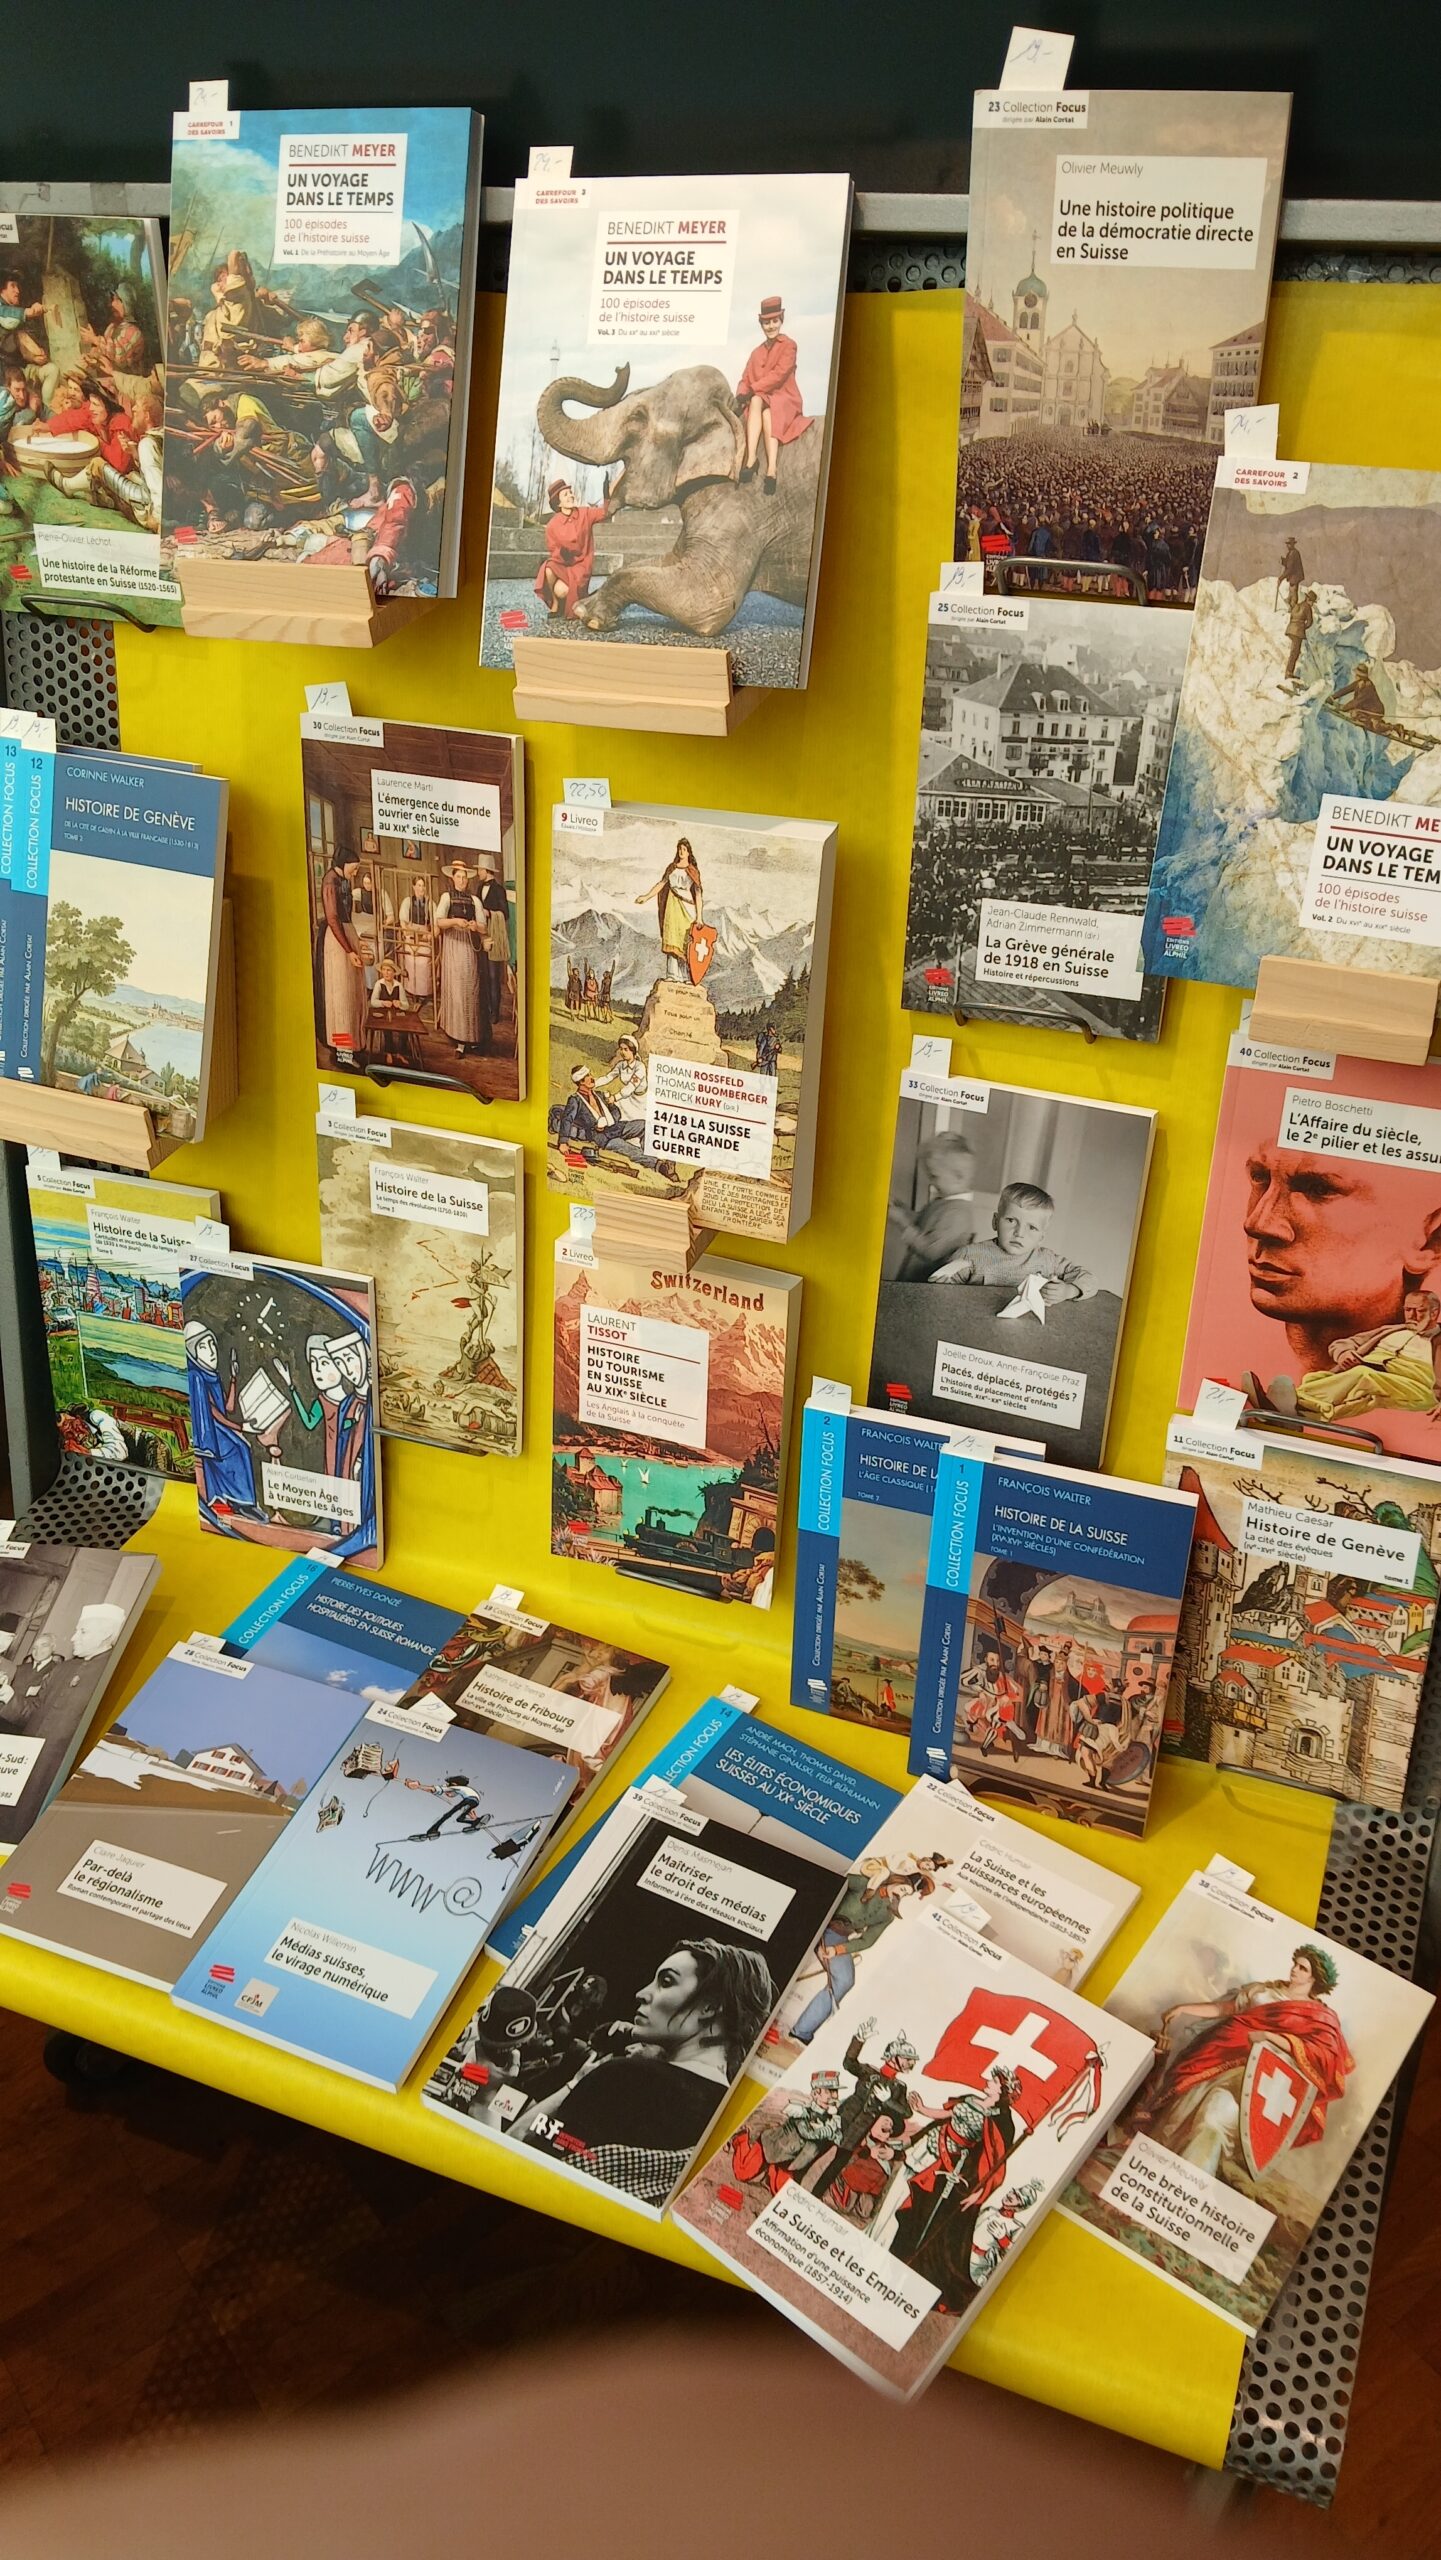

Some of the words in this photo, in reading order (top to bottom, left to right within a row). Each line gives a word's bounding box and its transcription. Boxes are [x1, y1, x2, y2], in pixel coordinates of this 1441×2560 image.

[1003, 102, 1053, 113] Collection
[1056, 102, 1086, 113] Focus
[289, 144, 348, 158] BENEDIKT
[351, 144, 396, 157] MEYER
[287, 173, 308, 188] UN
[311, 173, 369, 188] VOYAGE
[1061, 161, 1096, 174] Olivier
[1100, 162, 1143, 178] Meuwly
[286, 192, 324, 206] DANS
[327, 192, 343, 206] LE
[347, 192, 394, 206] TEMPS
[1060, 200, 1090, 216] Une
[1095, 200, 1156, 218] histoire
[1160, 202, 1234, 222] politique
[284, 219, 302, 229] 100
[305, 218, 347, 233] épisodes
[608, 222, 674, 235] BENEDIKT
[678, 221, 726, 234] MEYER
[1058, 221, 1077, 237] de
[1099, 222, 1191, 240] démocratie
[1195, 224, 1254, 242] directe
[340, 234, 370, 243] suisse
[1056, 246, 1075, 258] en
[1080, 243, 1129, 260] Suisse
[1236, 469, 1285, 478] CARREFOUR
[1252, 478, 1287, 487] SAVOIRS
[42, 558, 60, 568] Une
[62, 559, 95, 572] histoire
[120, 564, 157, 578] Réforme
[45, 573, 95, 586] protestante
[110, 577, 137, 589] Suisse
[951, 604, 995, 616] Collection
[997, 607, 1024, 618] Focus
[66, 766, 108, 783] CORINNE
[110, 773, 145, 789] WALKER
[31, 775, 41, 815] FOCUS
[65, 797, 119, 819] HISTOIRE
[124, 807, 140, 822] DE
[143, 809, 195, 832] GENÈVE
[378, 807, 413, 821] ouvrier
[430, 813, 459, 827] Suisse
[456, 803, 491, 819] monde
[570, 813, 598, 827] Livreo
[1332, 806, 1412, 829] BENEDIKT
[26, 817, 40, 889] COLLECTION
[1327, 835, 1354, 853] UN
[1358, 839, 1435, 864] VOYAGE
[1322, 855, 1373, 877] DANS
[1377, 862, 1397, 879] LE
[1403, 865, 1441, 885] TEM
[1005, 937, 1047, 955] Grève
[1051, 942, 1115, 963] générale
[983, 967, 1014, 979] Histoire
[1025, 972, 1079, 988] répercussions
[984, 951, 1001, 965] de
[1005, 954, 1039, 970] 1918
[1065, 960, 1109, 979] Suisse
[656, 1063, 692, 1079] ROMAN
[694, 1071, 744, 1088] ROSSFELD
[655, 1074, 696, 1092] THOMAS
[698, 1084, 768, 1105] BUOMBERGER
[655, 1087, 693, 1104] PATRICK
[695, 1096, 722, 1109] KURY
[1292, 1095, 1321, 1108] Pietro
[1325, 1099, 1373, 1116] Boschetti
[653, 1110, 688, 1126] 14/18
[708, 1121, 751, 1139] SUISSE
[1353, 1123, 1371, 1136] du
[1376, 1126, 1422, 1147] siècle,
[652, 1140, 701, 1159] GUERRE
[688, 1131, 740, 1152] GRANDE
[1321, 1134, 1359, 1151] pilier
[1382, 1144, 1401, 1157] les
[376, 1181, 418, 1198] Histoire
[449, 1195, 483, 1212] Suisse
[650, 1270, 765, 1312] Switzerland
[587, 1312, 637, 1332] LAURENT
[587, 1325, 628, 1341] TISSOT
[587, 1345, 641, 1365] HISTOIRE
[605, 1361, 665, 1383] TOURISME
[605, 1373, 643, 1390] SUISSE
[942, 1363, 973, 1379] Placés,
[977, 1371, 1022, 1390] déplacés,
[1026, 1383, 1070, 1401] protégés
[630, 1389, 667, 1408] SIÈCLE
[283, 1483, 316, 1498] Moyen
[319, 1490, 338, 1503] Âge
[953, 1480, 969, 1519] FOCUS
[998, 1476, 1050, 1498] FRANÇOIS
[1053, 1488, 1092, 1506] WALTER
[277, 1493, 311, 1508] travers
[314, 1501, 327, 1511] les
[331, 1503, 354, 1517] âges
[1248, 1502, 1292, 1519] Mathieu
[1295, 1512, 1333, 1528] Caesar
[994, 1505, 1046, 1527] HISTOIRE
[1050, 1517, 1067, 1531] DE
[1086, 1526, 1129, 1546] SUISSE
[1246, 1516, 1311, 1541] Histoire
[1316, 1531, 1337, 1546] de
[1342, 1538, 1405, 1562] Genève
[946, 1522, 964, 1588] COLLECTION
[238, 1601, 282, 1644] COLLECTION
[281, 1573, 310, 1603] FOCUS
[315, 1593, 347, 1611] HISTOIRE
[346, 1605, 364, 1616] DES
[364, 1610, 404, 1632] POLITIQUES
[370, 1623, 395, 1641] SUISSE
[395, 1632, 437, 1656] ROMANDE
[472, 1681, 514, 1704] Histoire
[530, 1702, 576, 1728] Fribourg
[716, 1758, 757, 1785] SUISSES
[757, 1781, 774, 1794] AU
[795, 1796, 831, 1824] SIÈCLE
[725, 1747, 740, 1760] LES
[743, 1754, 774, 1778] ÉLITES
[775, 1770, 862, 1824] ÉCONOMIQUES
[83, 1858, 133, 1883] Par-delà
[658, 1853, 713, 1883] Maîtriser
[983, 1859, 1016, 1881] Suisse
[1031, 1880, 1046, 1897] les
[87, 1876, 164, 1909] régionalisme
[665, 1872, 695, 1891] droit
[697, 1886, 719, 1901] des
[721, 1896, 767, 1922] médias
[962, 1861, 1018, 1896] puissances
[1020, 1893, 1092, 1935] européennes
[280, 1936, 322, 1959] Médias
[323, 1951, 366, 1978] suisses,
[286, 1955, 321, 1976] virage
[322, 1969, 388, 2002] numérique
[1128, 2156, 1157, 2181] Une
[1159, 2175, 1198, 2208] brève
[1201, 2201, 1255, 2243] histoire
[1111, 2185, 1129, 2203] de
[1131, 2196, 1144, 2213] la
[1147, 2207, 1191, 2241] Suisse
[1120, 2172, 1240, 2253] constitutionnelle
[755, 2227, 804, 2268] économique
[772, 2200, 788, 2219] La
[789, 2214, 830, 2250] Suisse
[830, 2247, 845, 2262] et
[845, 2255, 865, 2277] les
[865, 2272, 920, 2319] Empires
[762, 2217, 807, 2255] Affirmation
[830, 2268, 871, 2304] puissance
